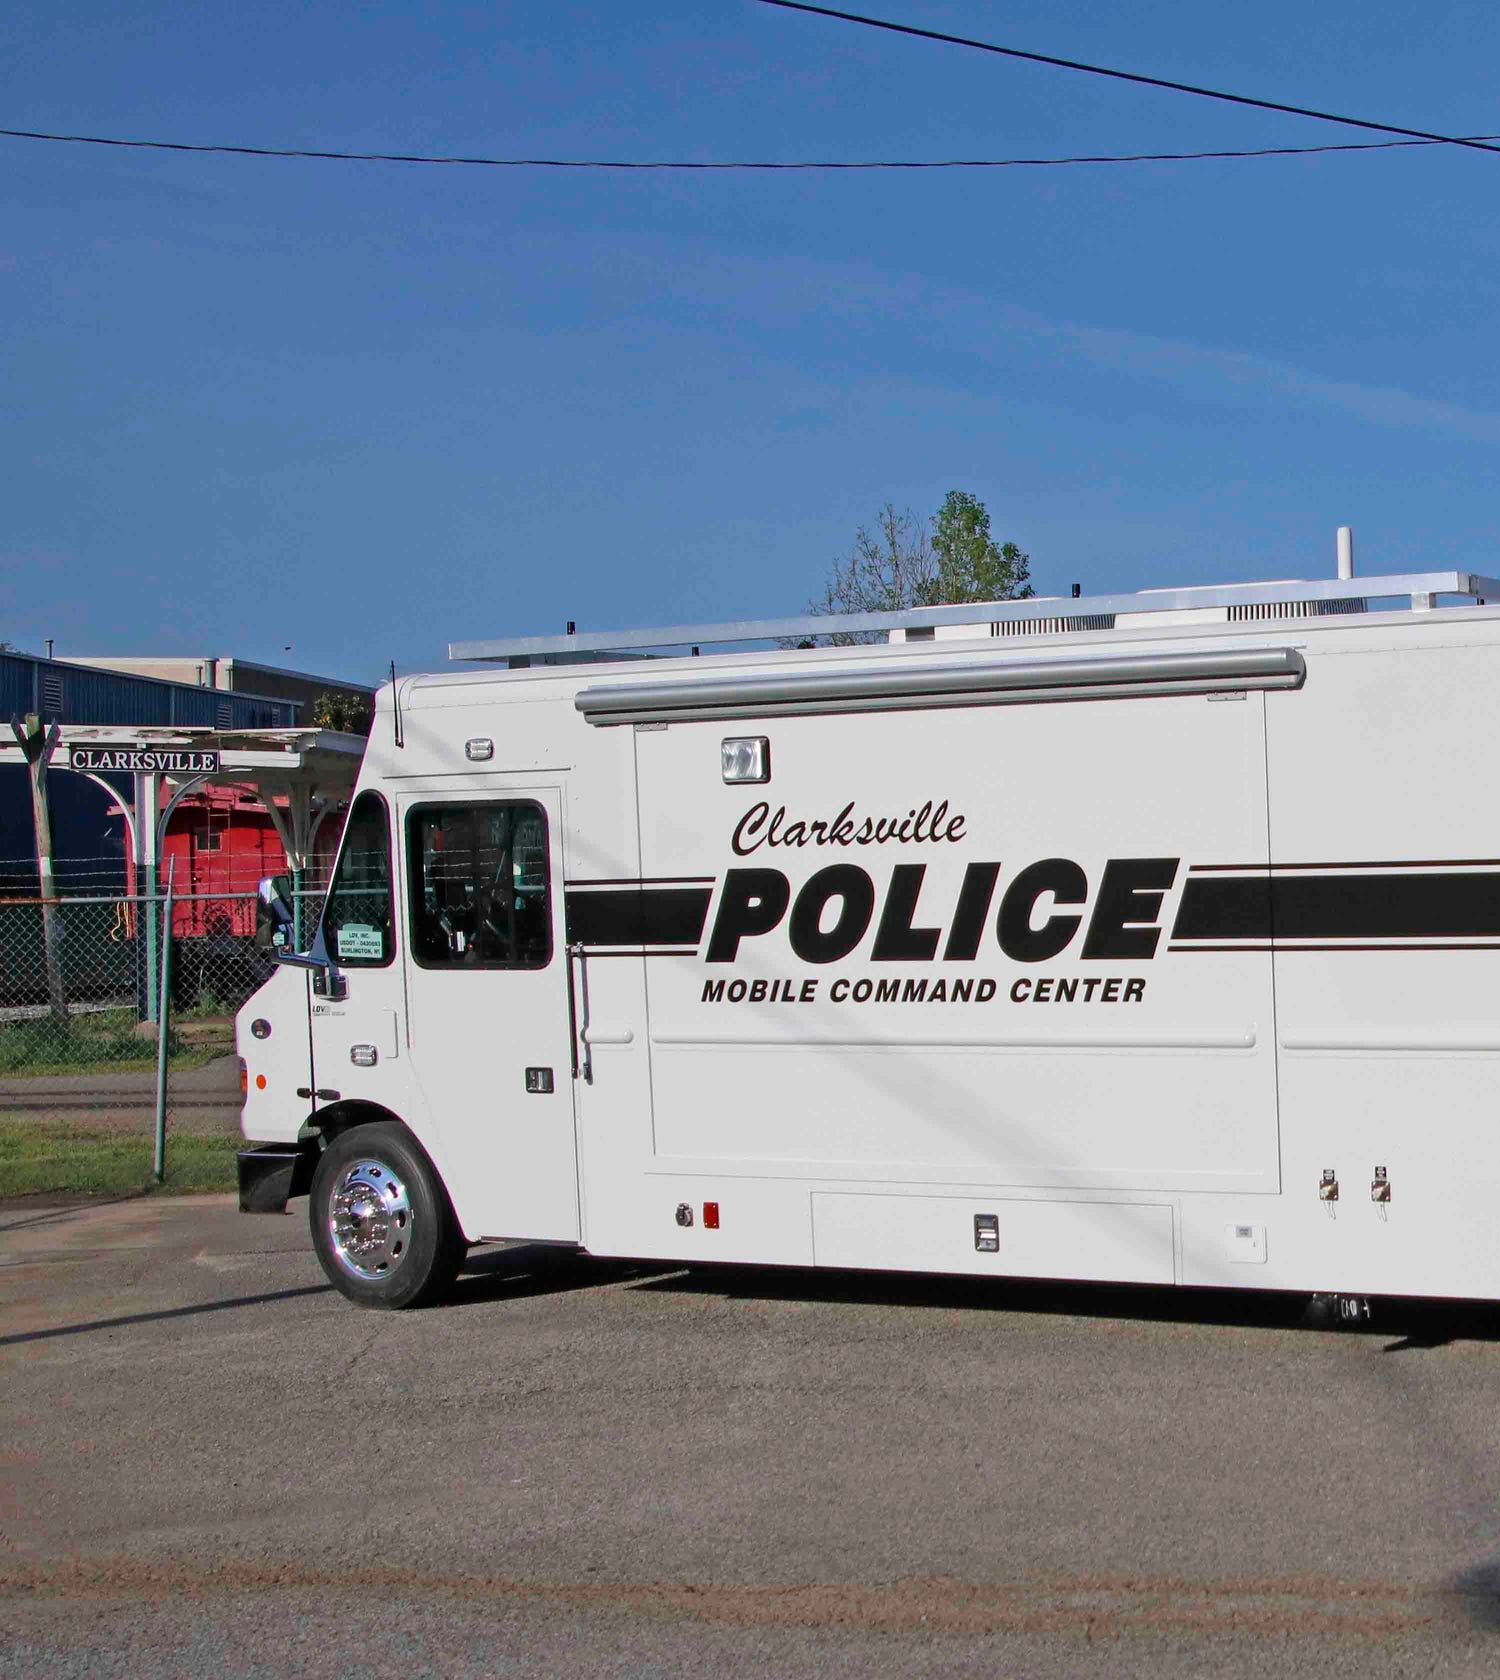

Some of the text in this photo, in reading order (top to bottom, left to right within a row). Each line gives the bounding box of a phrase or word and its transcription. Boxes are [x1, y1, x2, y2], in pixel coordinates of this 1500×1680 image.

[72, 751, 215, 771] CLARKSVILLE
[732, 800, 967, 856] Clarksville
[706, 858, 1180, 963] POLICE
[701, 979, 1146, 1003] MOBILE COMMAND CENTER
